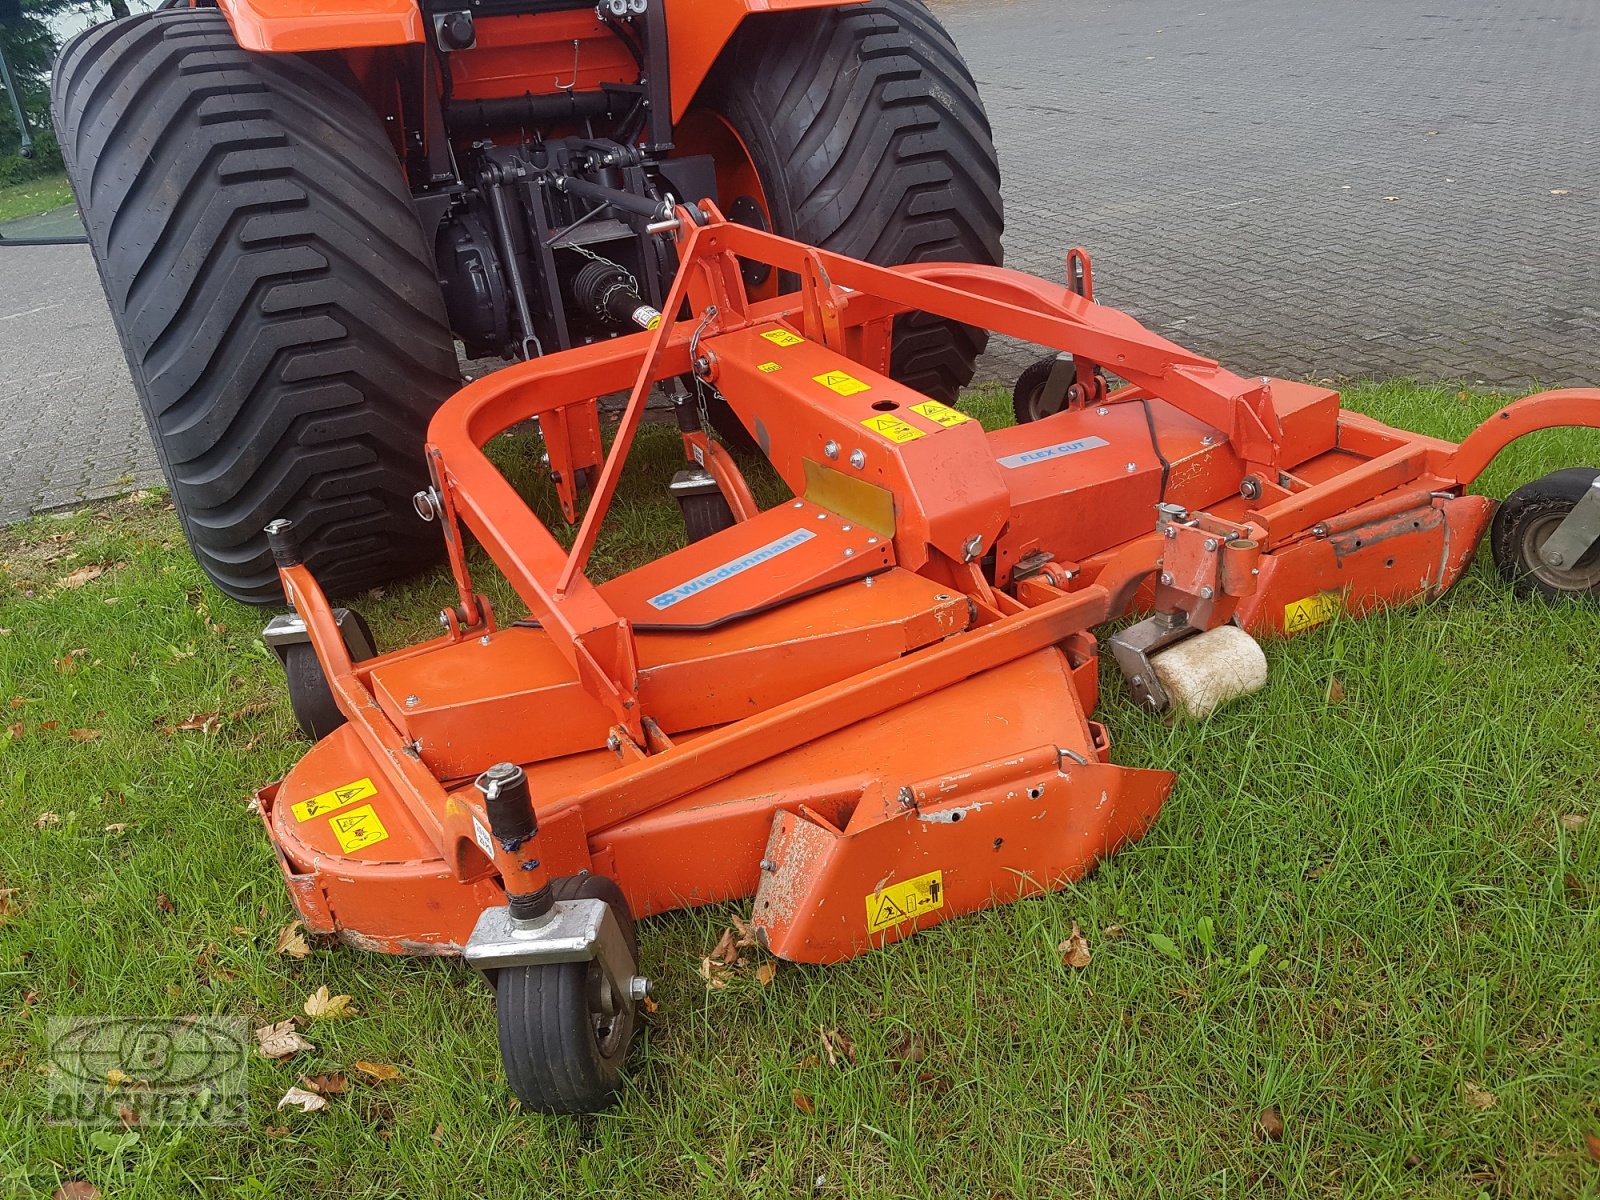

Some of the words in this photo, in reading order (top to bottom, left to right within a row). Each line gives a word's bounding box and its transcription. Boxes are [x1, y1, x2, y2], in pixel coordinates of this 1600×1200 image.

[1020, 448, 1057, 462] FLEX
[1057, 441, 1085, 453] CUT
[676, 532, 808, 596] Wiedenmann
